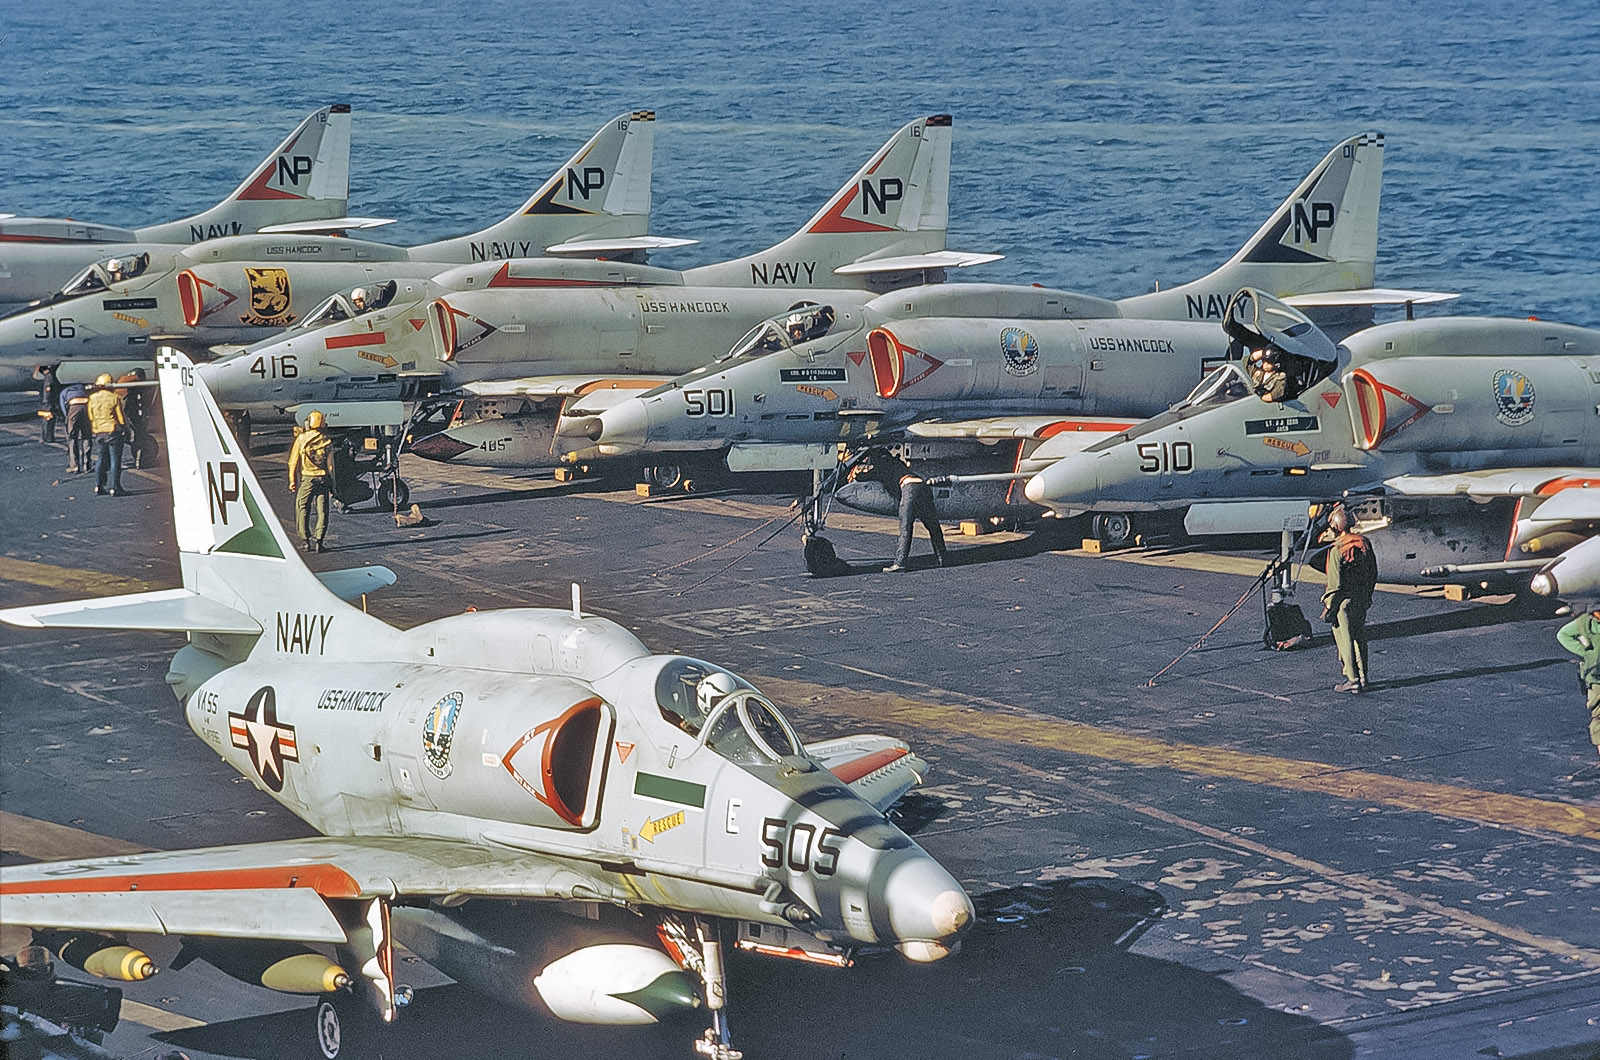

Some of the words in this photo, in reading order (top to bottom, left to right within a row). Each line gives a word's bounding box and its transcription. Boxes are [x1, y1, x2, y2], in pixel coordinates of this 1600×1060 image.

[316, 113, 327, 123] 12
[617, 120, 628, 131] 16
[909, 126, 921, 137] 16
[278, 155, 313, 186] NP
[567, 167, 605, 200] NP
[861, 177, 903, 215] NP
[1294, 202, 1335, 243] NP
[470, 241, 531, 261] NAVY
[750, 261, 817, 285] NAVY
[669, 302, 730, 313] HANCOCK
[33, 317, 76, 339] 316
[1116, 338, 1175, 353] HANCOCK
[250, 354, 299, 379] 416
[682, 388, 735, 417] 501
[1136, 441, 1193, 473] 510
[207, 461, 240, 526] NP
[276, 611, 335, 656] NAVY
[653, 813, 681, 833] RESCUE
[760, 816, 851, 877] 505
